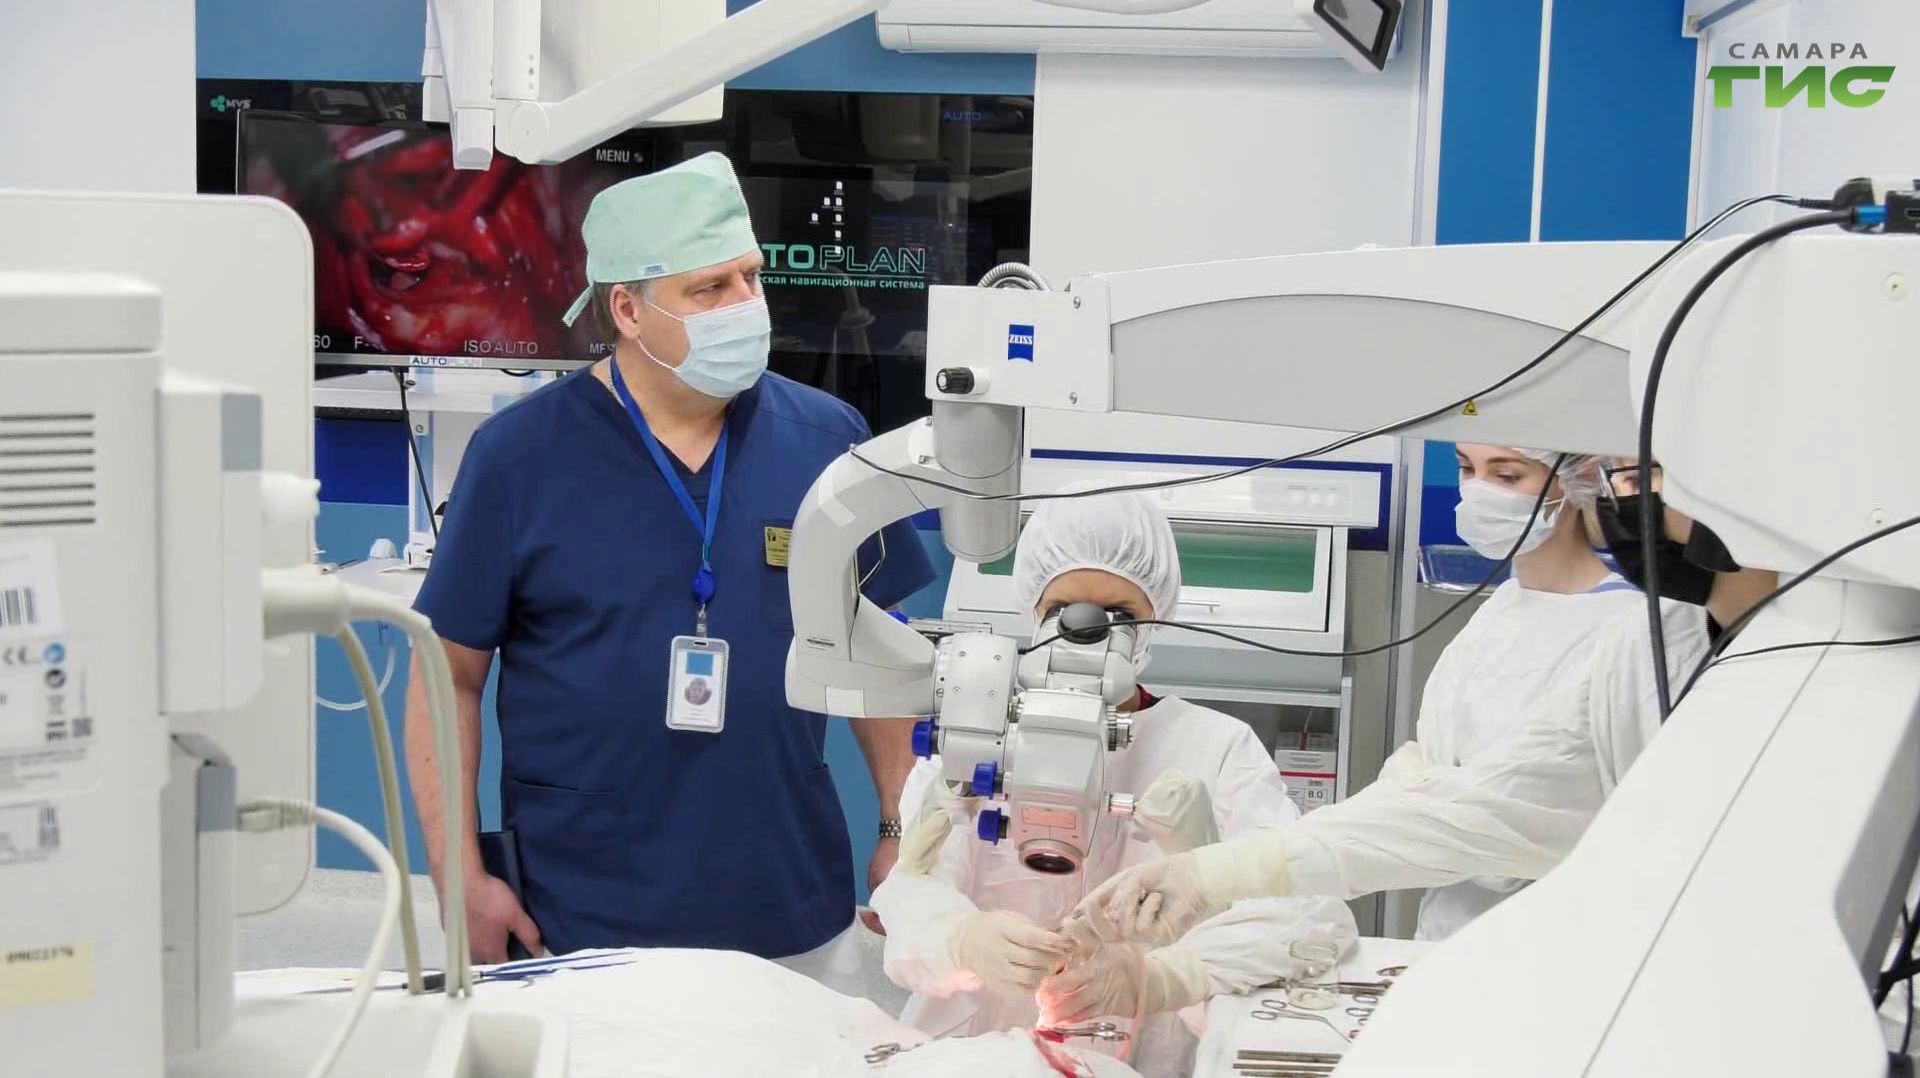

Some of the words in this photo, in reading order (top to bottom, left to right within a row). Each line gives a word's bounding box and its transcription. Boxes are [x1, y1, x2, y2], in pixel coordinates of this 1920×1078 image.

[596, 148, 630, 163] MENU
[761, 243, 926, 274] TOPLAN
[758, 276, 787, 285] ская
[790, 276, 876, 288] навигационная
[879, 281, 925, 289] система
[463, 339, 492, 353] ISO
[493, 340, 539, 355] AUTO
[1009, 334, 1033, 345] ZEISS
